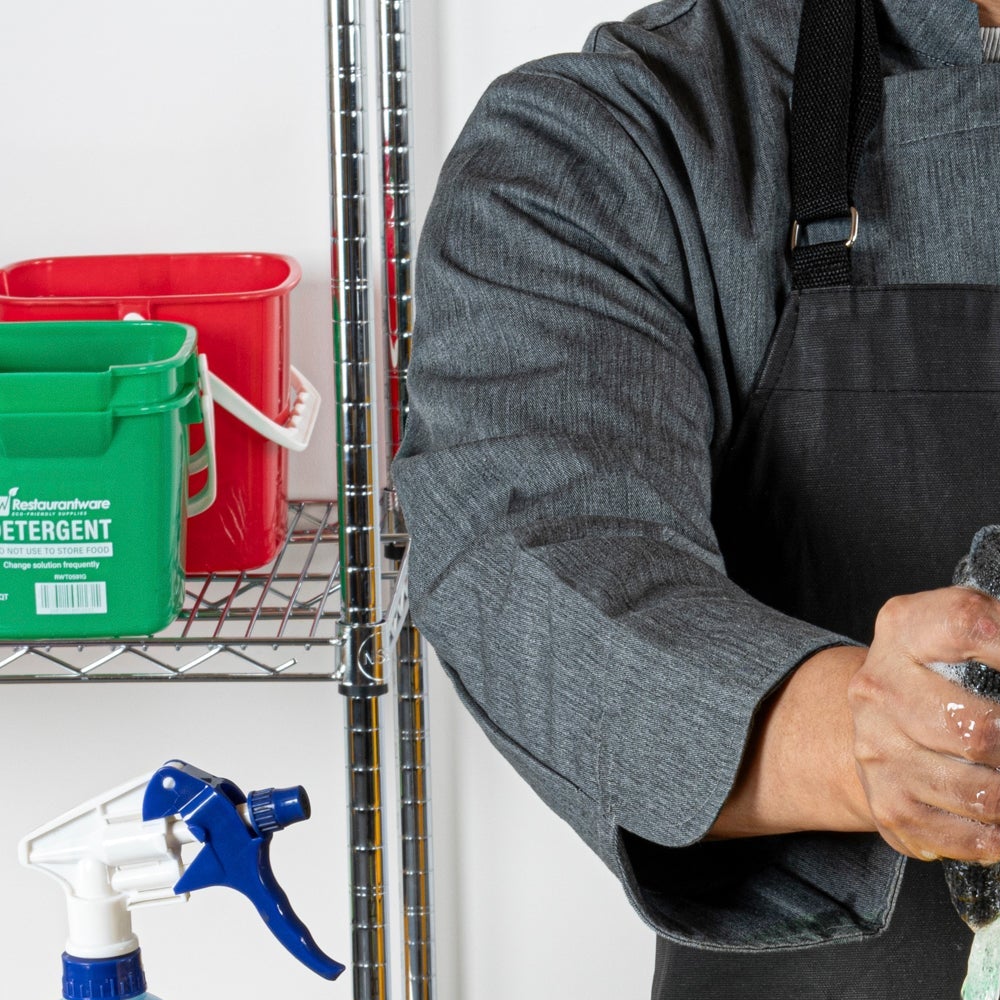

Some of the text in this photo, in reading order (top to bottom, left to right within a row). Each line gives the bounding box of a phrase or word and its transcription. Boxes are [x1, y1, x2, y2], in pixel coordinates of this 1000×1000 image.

[12, 498, 110, 511] Restaurantware
[0, 519, 112, 541] ETERGENT
[7, 547, 24, 555] NOT
[26, 547, 44, 555] USE
[45, 546, 55, 555] TO
[57, 546, 83, 555] STORE
[86, 546, 110, 554] FOOD
[3, 560, 100, 570] Change solution frequently
